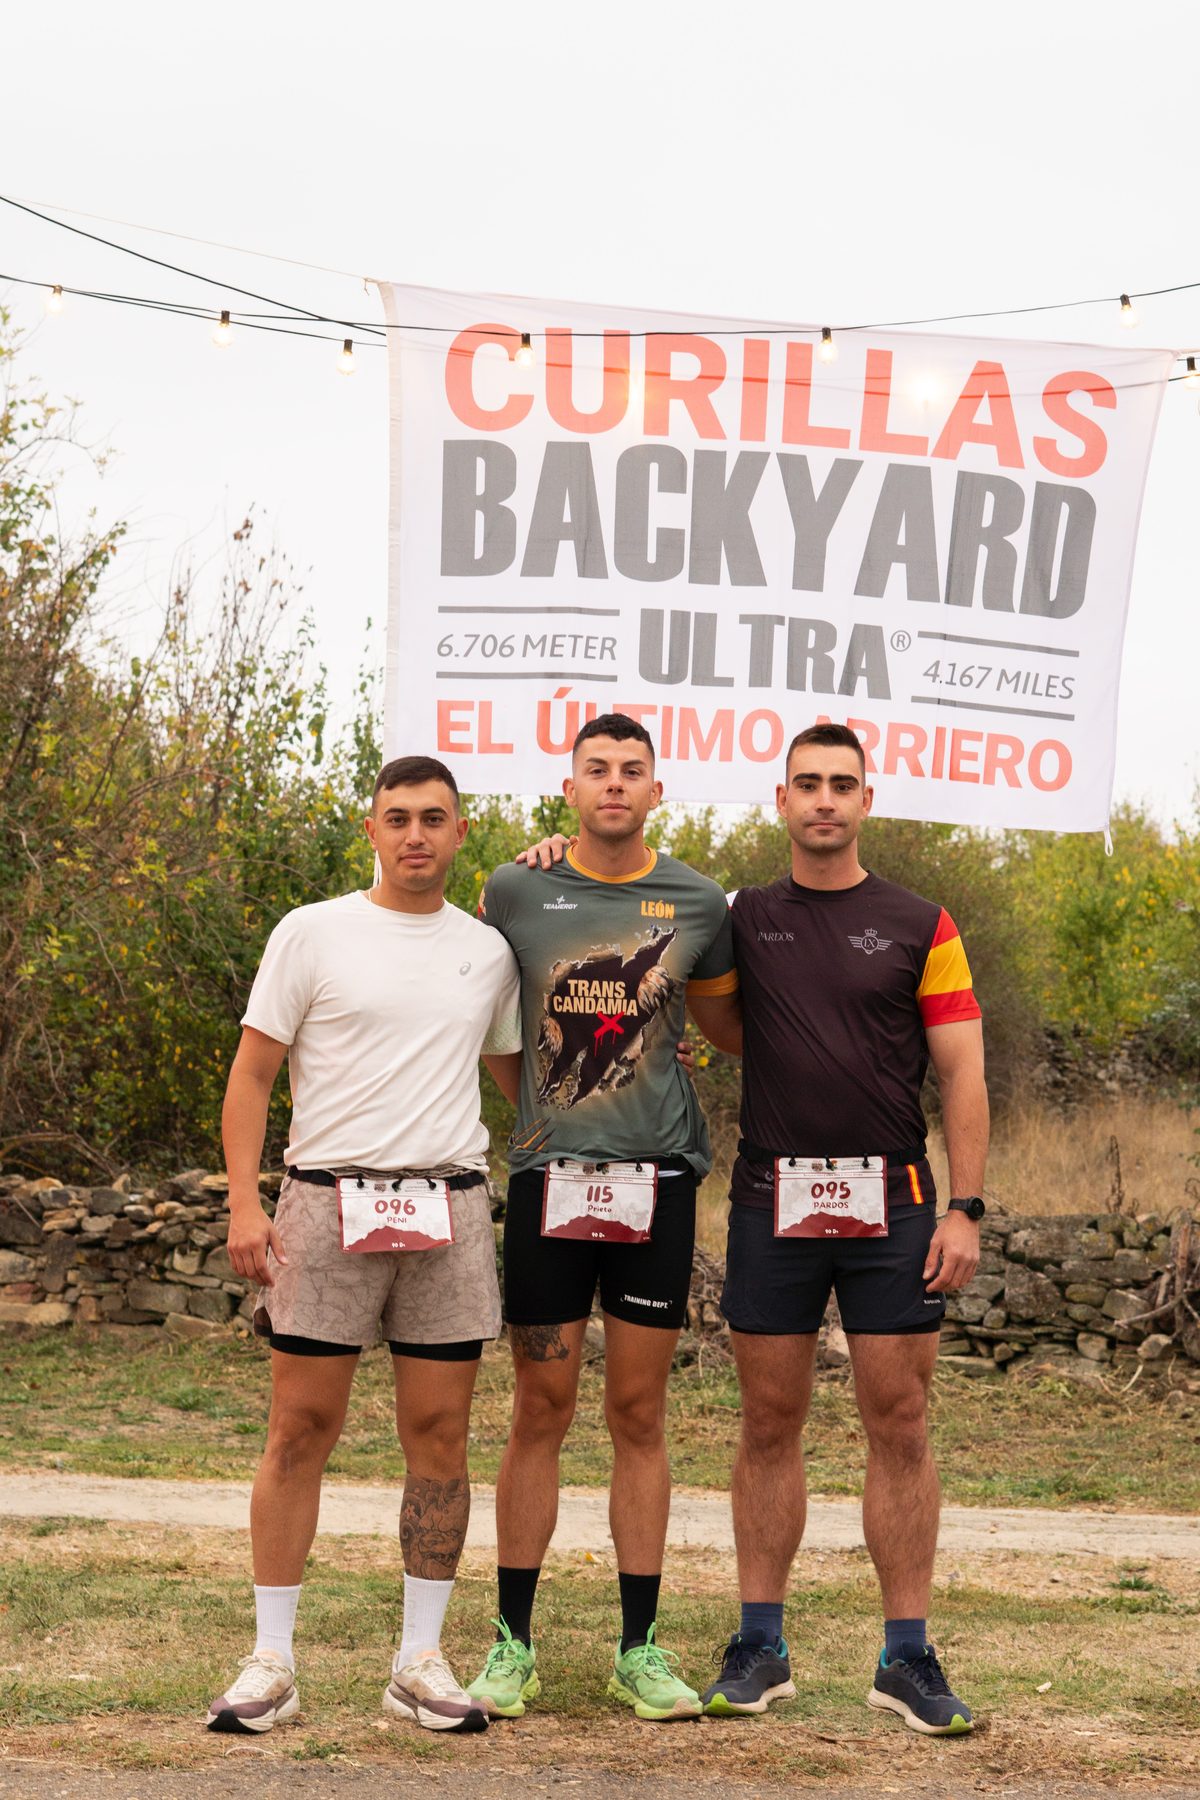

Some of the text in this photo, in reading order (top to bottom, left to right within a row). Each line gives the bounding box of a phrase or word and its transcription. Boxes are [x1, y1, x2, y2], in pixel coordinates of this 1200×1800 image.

[445, 323, 1117, 478] CURILLAS
[439, 439, 1098, 619] BACKYARD
[437, 634, 617, 660] 6.706 METER
[923, 660, 1075, 699] 4.167 MILES
[436, 699, 514, 754] EL
[814, 714, 1073, 792] RRIERO
[640, 900, 675, 919] LEÓN
[757, 931, 795, 943] PARDOS
[567, 979, 626, 998] TRANS
[553, 996, 638, 1016] CANDAMIA
[587, 1185, 614, 1203] 115
[811, 1181, 851, 1200] 095
[374, 1198, 416, 1215] 096
[588, 1205, 612, 1213] Prieto
[813, 1201, 849, 1209] PARDOS
[624, 1294, 652, 1307] TRAINING
